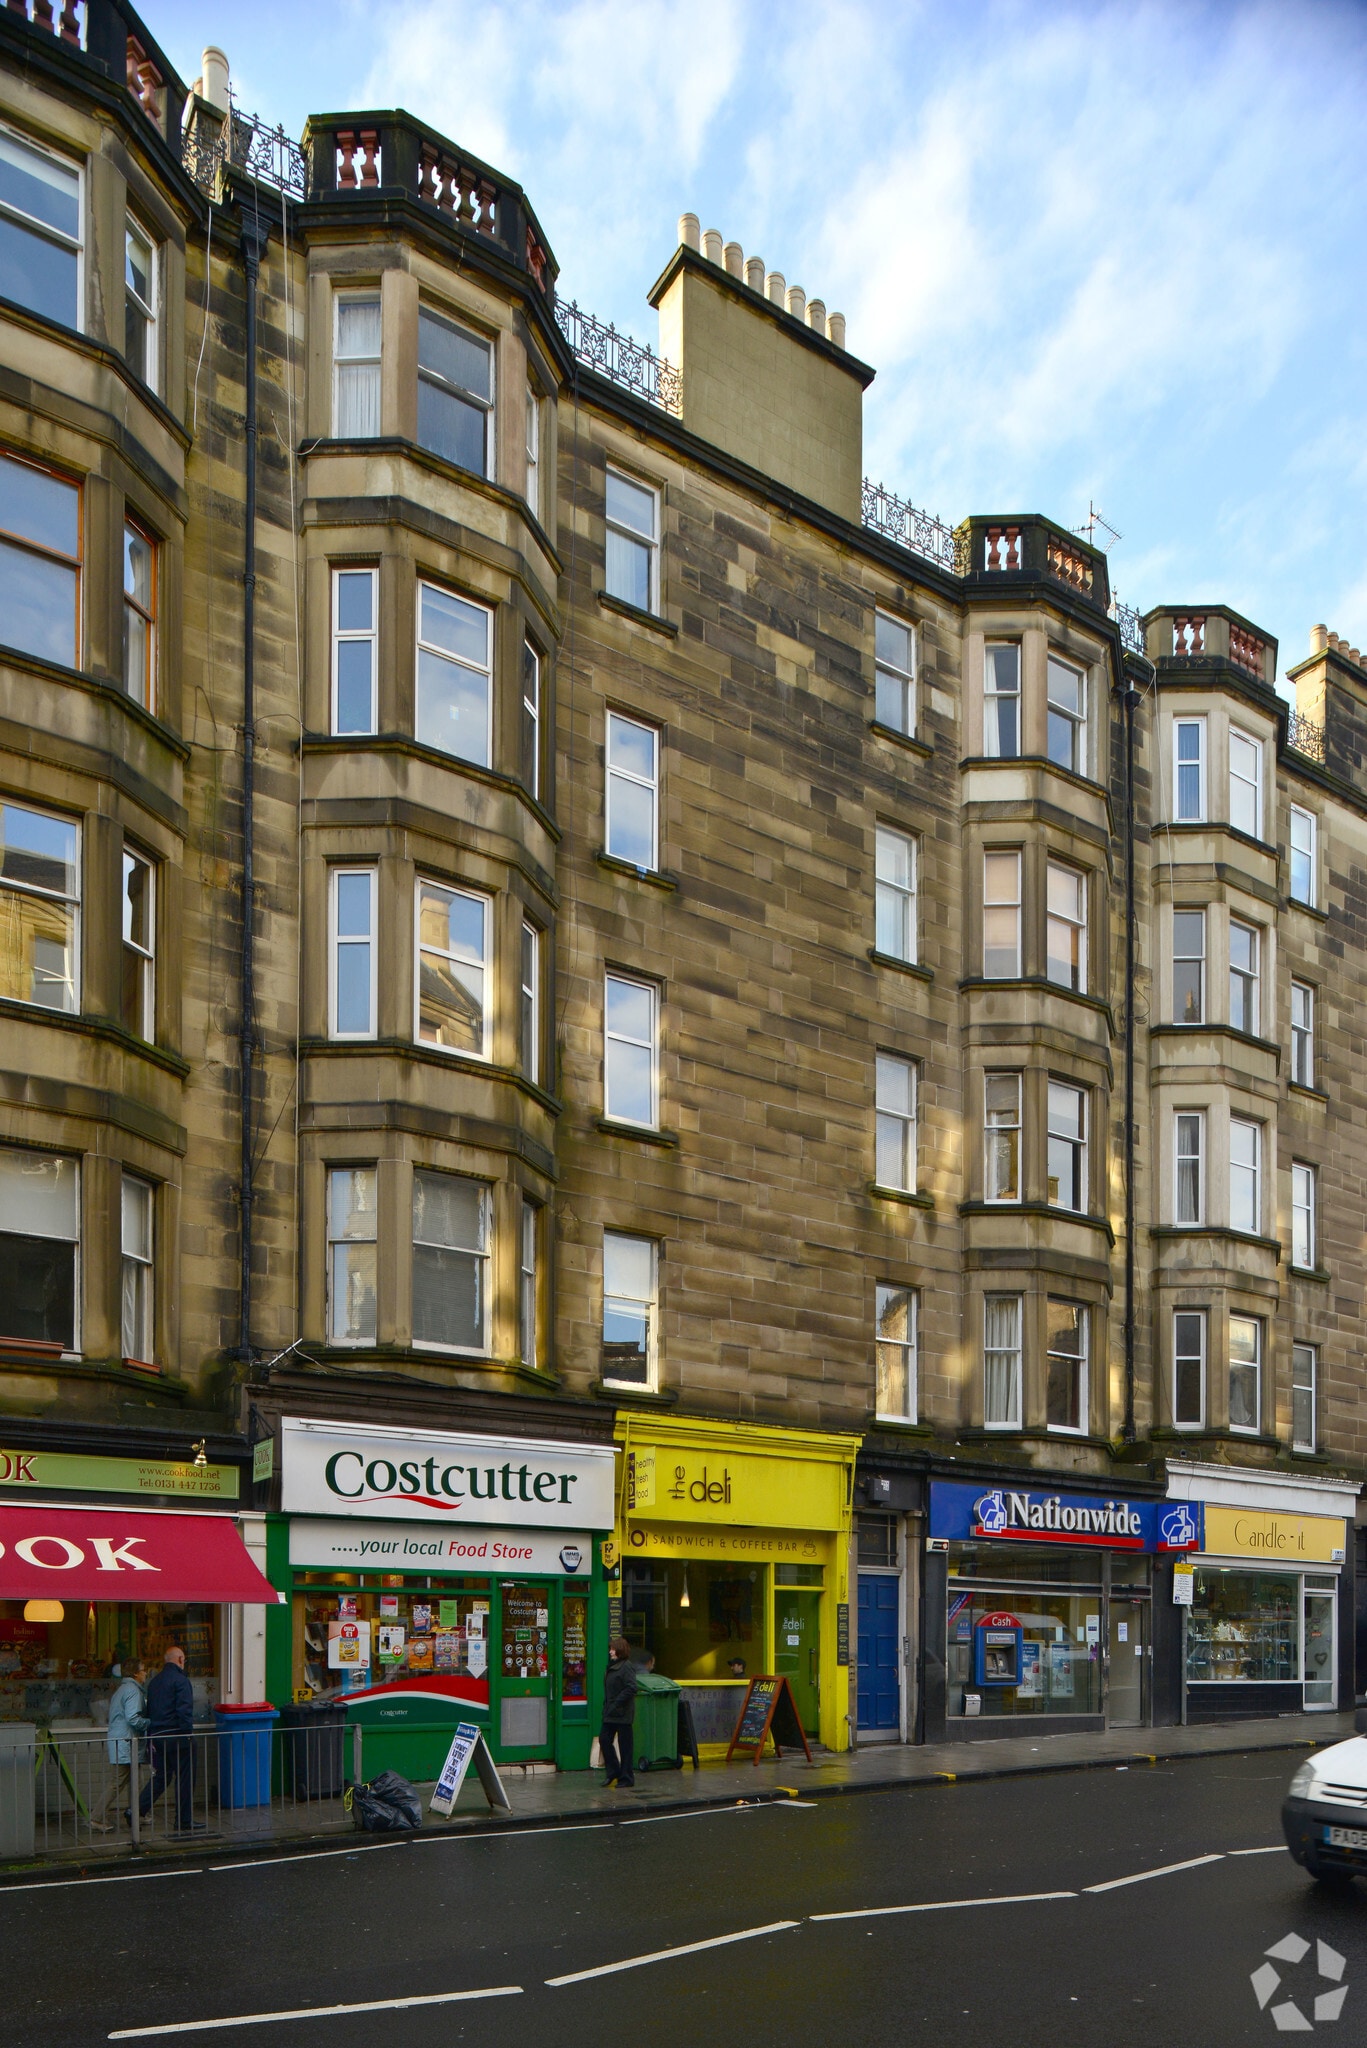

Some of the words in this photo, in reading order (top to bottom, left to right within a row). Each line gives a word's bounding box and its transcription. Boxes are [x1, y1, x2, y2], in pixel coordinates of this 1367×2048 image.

[636, 1457, 655, 1468] healthy
[138, 1466, 220, 1480] www.cookfood.net
[325, 1451, 578, 1504] Costcutter
[138, 1478, 153, 1487] Tel:
[155, 1479, 175, 1489] 0131
[180, 1481, 196, 1490] 447
[200, 1482, 221, 1491] 1736
[668, 1465, 686, 1499] the
[690, 1466, 731, 1504] deli
[636, 1488, 649, 1499] food
[1004, 1491, 1141, 1535] Nationwide
[403, 1538, 443, 1556] local
[448, 1541, 488, 1557] Food
[491, 1542, 533, 1559] Store
[653, 1534, 714, 1547] SANDWICH
[719, 1538, 726, 1548] &
[732, 1539, 773, 1551] COFFEE
[778, 1541, 798, 1551] BAR
[0, 1536, 162, 1571] OK
[507, 1599, 534, 1607] Welcome
[535, 1600, 542, 1608] to
[509, 1607, 537, 1615] Costcutte
[788, 1617, 804, 1630] deli
[991, 1616, 1011, 1626] Cash
